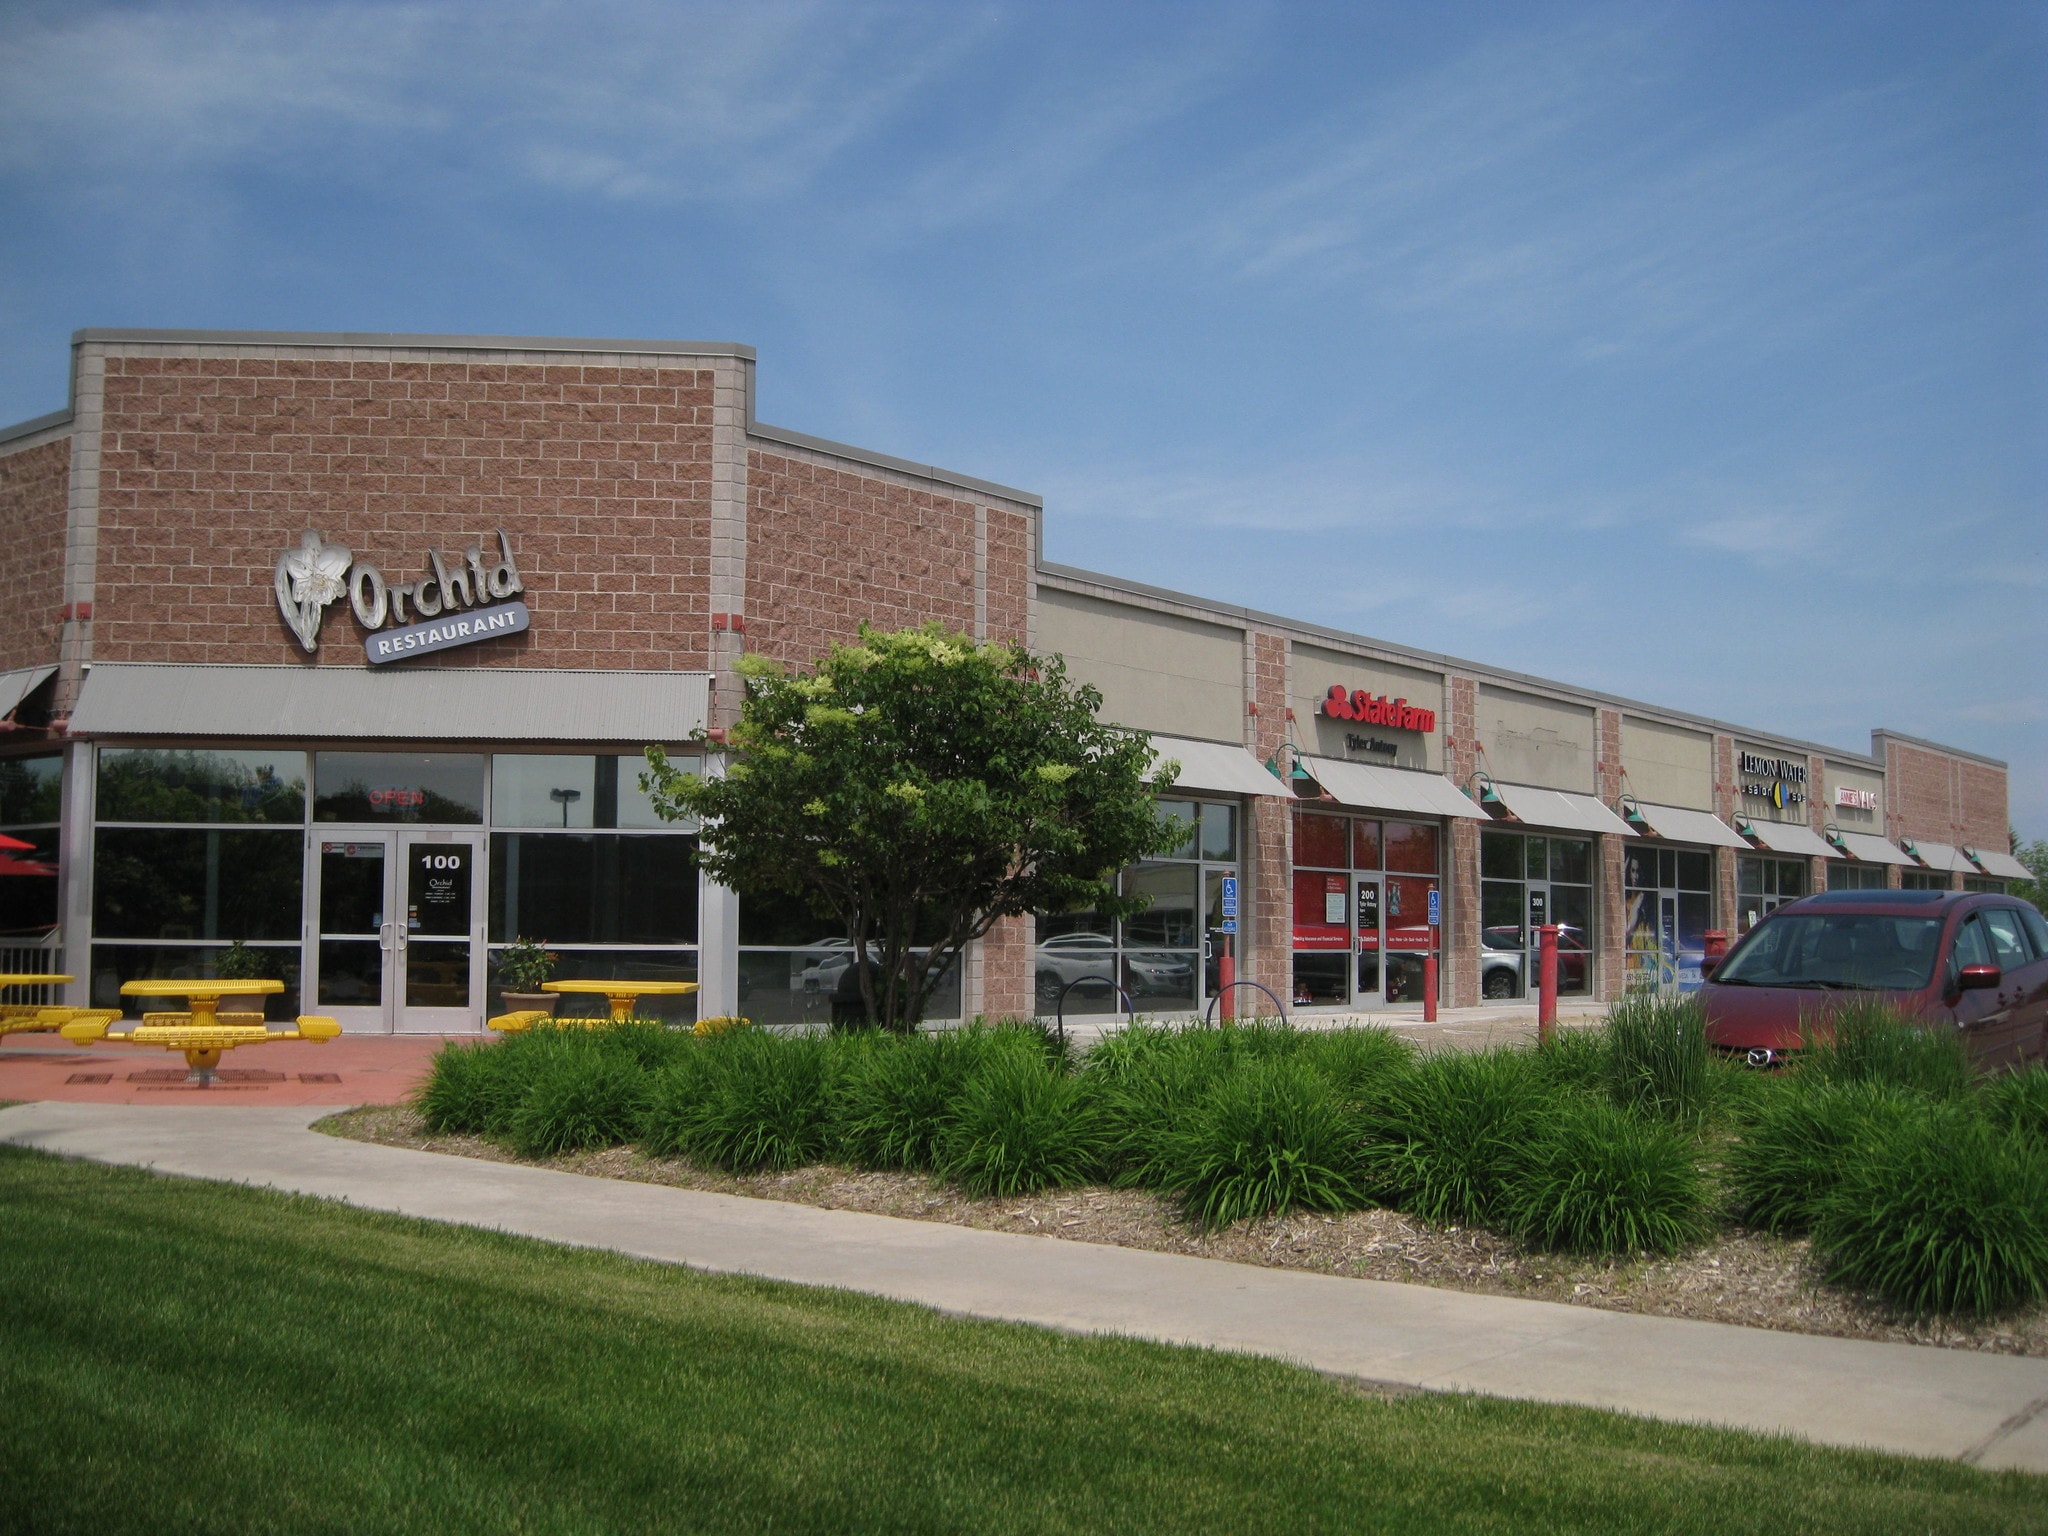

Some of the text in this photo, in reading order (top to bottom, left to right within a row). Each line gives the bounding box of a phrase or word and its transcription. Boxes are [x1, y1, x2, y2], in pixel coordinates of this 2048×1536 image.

[350, 527, 525, 629] Orchid
[377, 610, 517, 655] RESTAURANT
[1743, 751, 1808, 784] LEMON WATER
[1748, 784, 1772, 797] salon
[369, 790, 424, 806] OPEN
[421, 855, 460, 869] 100
[429, 878, 453, 887] Orchid
[1361, 890, 1375, 900] 200
[1532, 897, 1544, 907] 300
